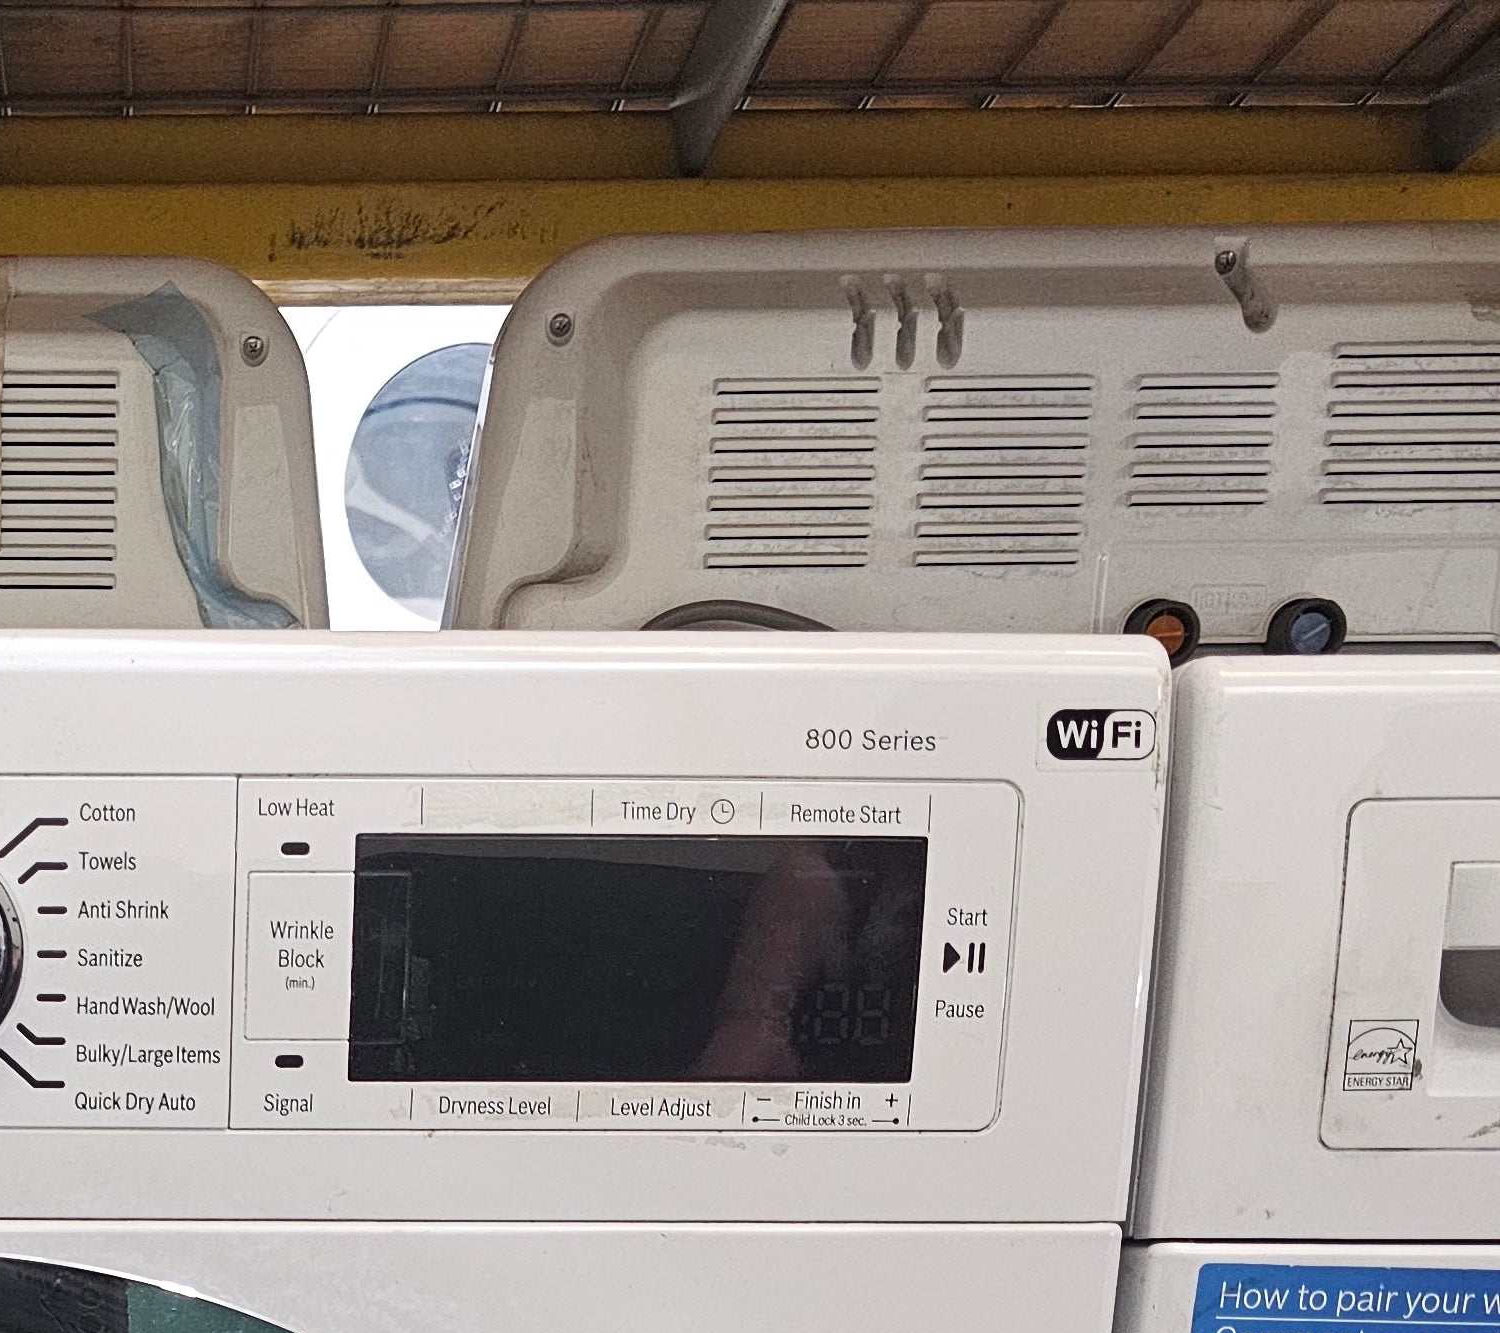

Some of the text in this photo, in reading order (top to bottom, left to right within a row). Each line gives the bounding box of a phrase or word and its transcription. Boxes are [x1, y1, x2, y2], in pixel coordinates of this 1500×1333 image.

[805, 729, 936, 752] 800 Series
[79, 803, 136, 822] Cotton
[258, 798, 335, 817] Low Heat
[621, 801, 696, 825] Time Dry
[791, 804, 901, 826] Remote Start
[79, 852, 137, 871] Towels
[78, 900, 169, 919] Anti Shrink
[947, 908, 988, 927] Start
[270, 920, 334, 940] Wrinkle
[77, 949, 144, 968] Sanitize
[278, 949, 325, 969] Block
[285, 975, 315, 991] (min.)
[77, 996, 216, 1019] Hand Wash/Wool
[935, 1000, 985, 1019] Pause
[76, 1044, 221, 1068] Bulky/Large Items
[1347, 1076, 1410, 1087] ENERGY STAR
[75, 1091, 196, 1115] Quick Dry Auto
[263, 1093, 313, 1116] Signal
[509, 1096, 551, 1116] Level
[611, 1097, 712, 1120] Level Adjust
[794, 1090, 861, 1110] Finish in
[784, 1113, 868, 1127] Child Lock 3 sec.
[1219, 1281, 1290, 1310] How
[1298, 1284, 1328, 1312] to
[1336, 1283, 1398, 1317] pair
[1403, 1290, 1475, 1319] your
